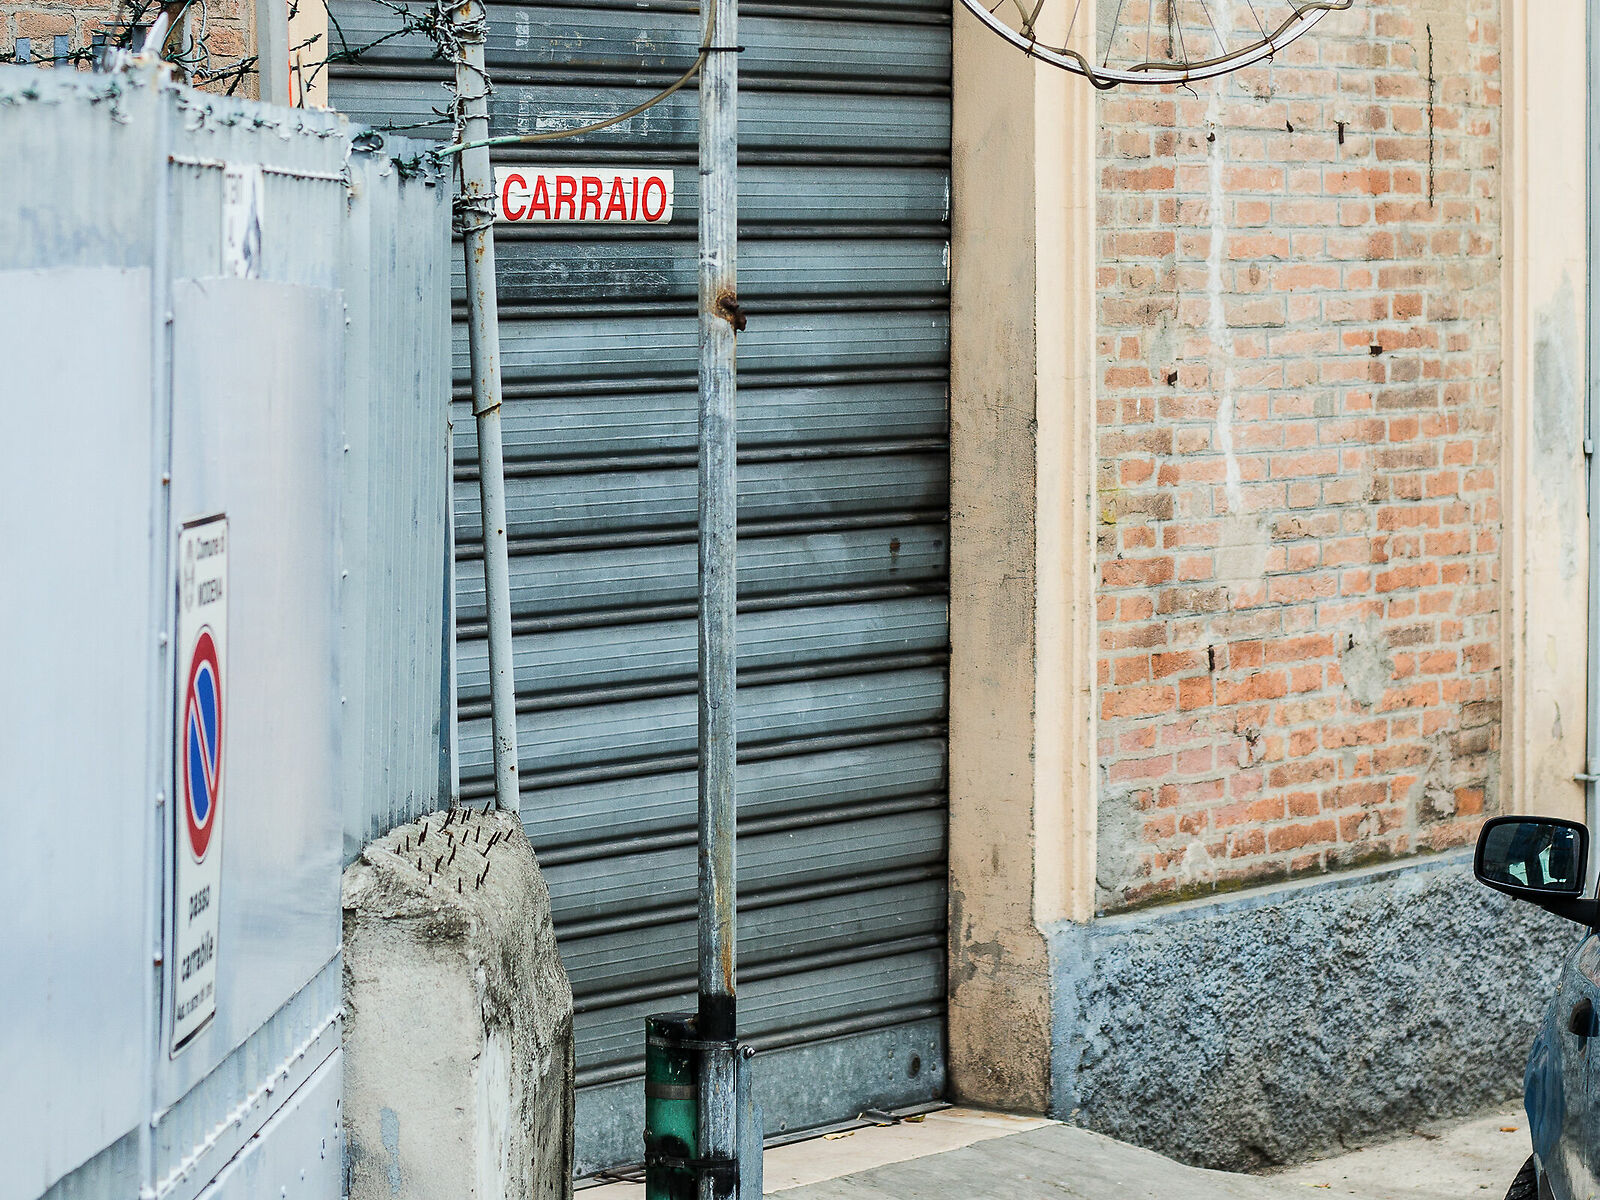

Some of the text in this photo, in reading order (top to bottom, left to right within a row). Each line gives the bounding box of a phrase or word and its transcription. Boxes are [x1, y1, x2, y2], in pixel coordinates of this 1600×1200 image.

[502, 173, 668, 223] CARRAIO
[188, 884, 211, 928] passo
[181, 930, 214, 983] carrabile
